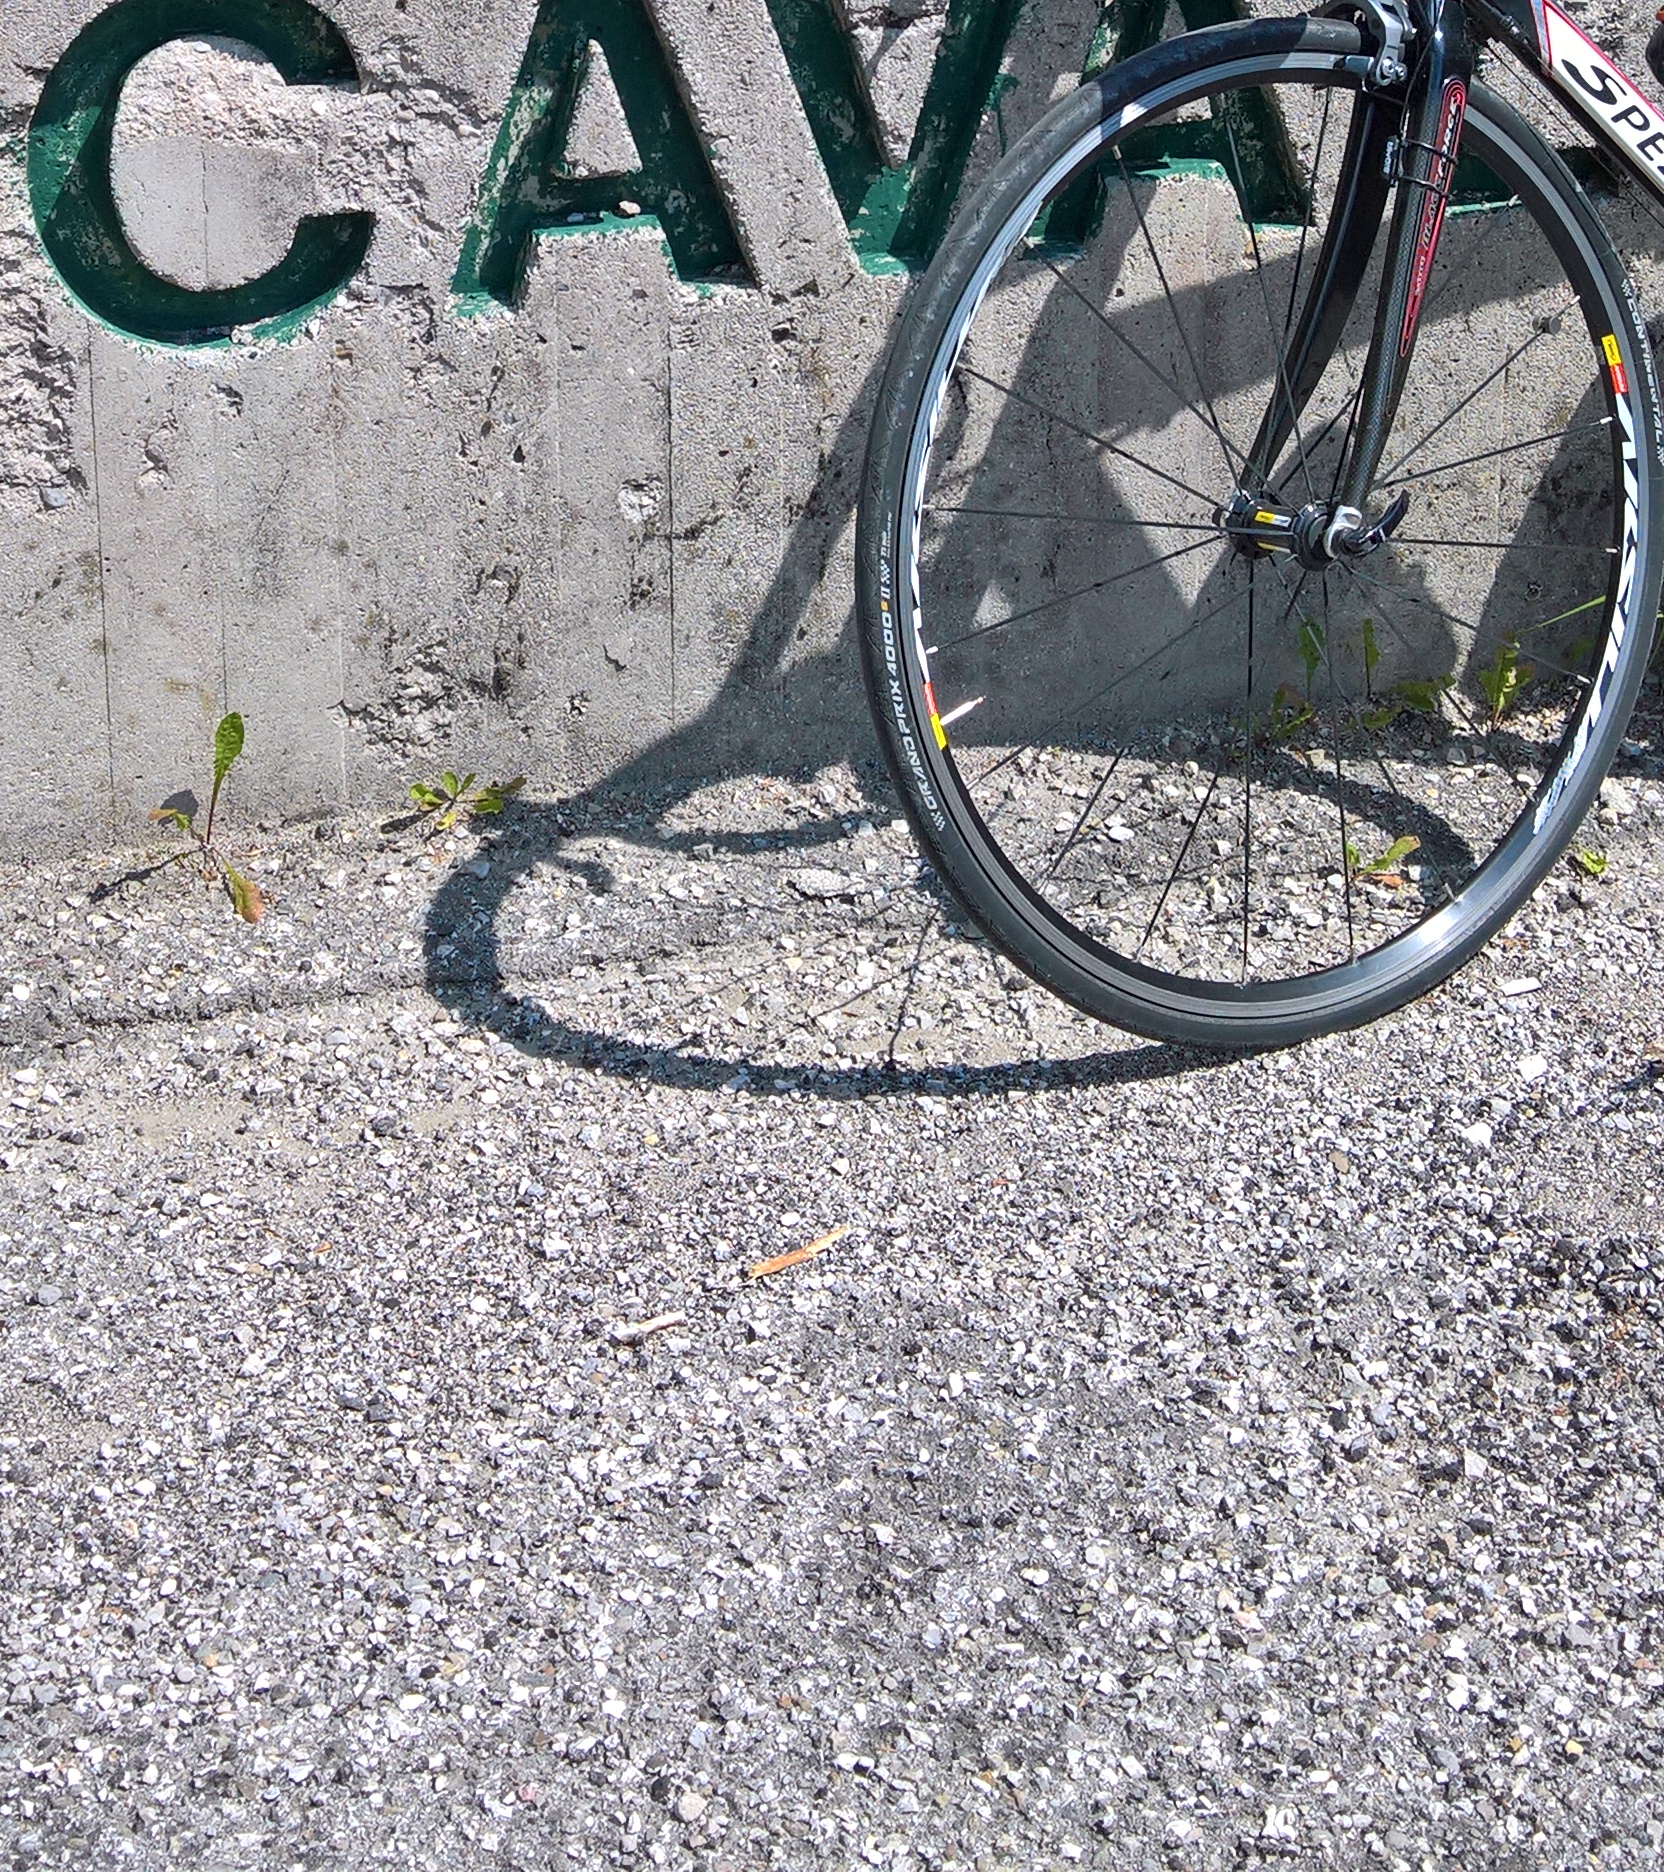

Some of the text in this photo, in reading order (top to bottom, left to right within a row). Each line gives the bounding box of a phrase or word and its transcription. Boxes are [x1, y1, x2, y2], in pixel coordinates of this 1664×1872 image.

[1626, 297, 1663, 447] CONTINENTAL
[889, 678, 911, 734] PRIX
[902, 734, 938, 810] GRAND
